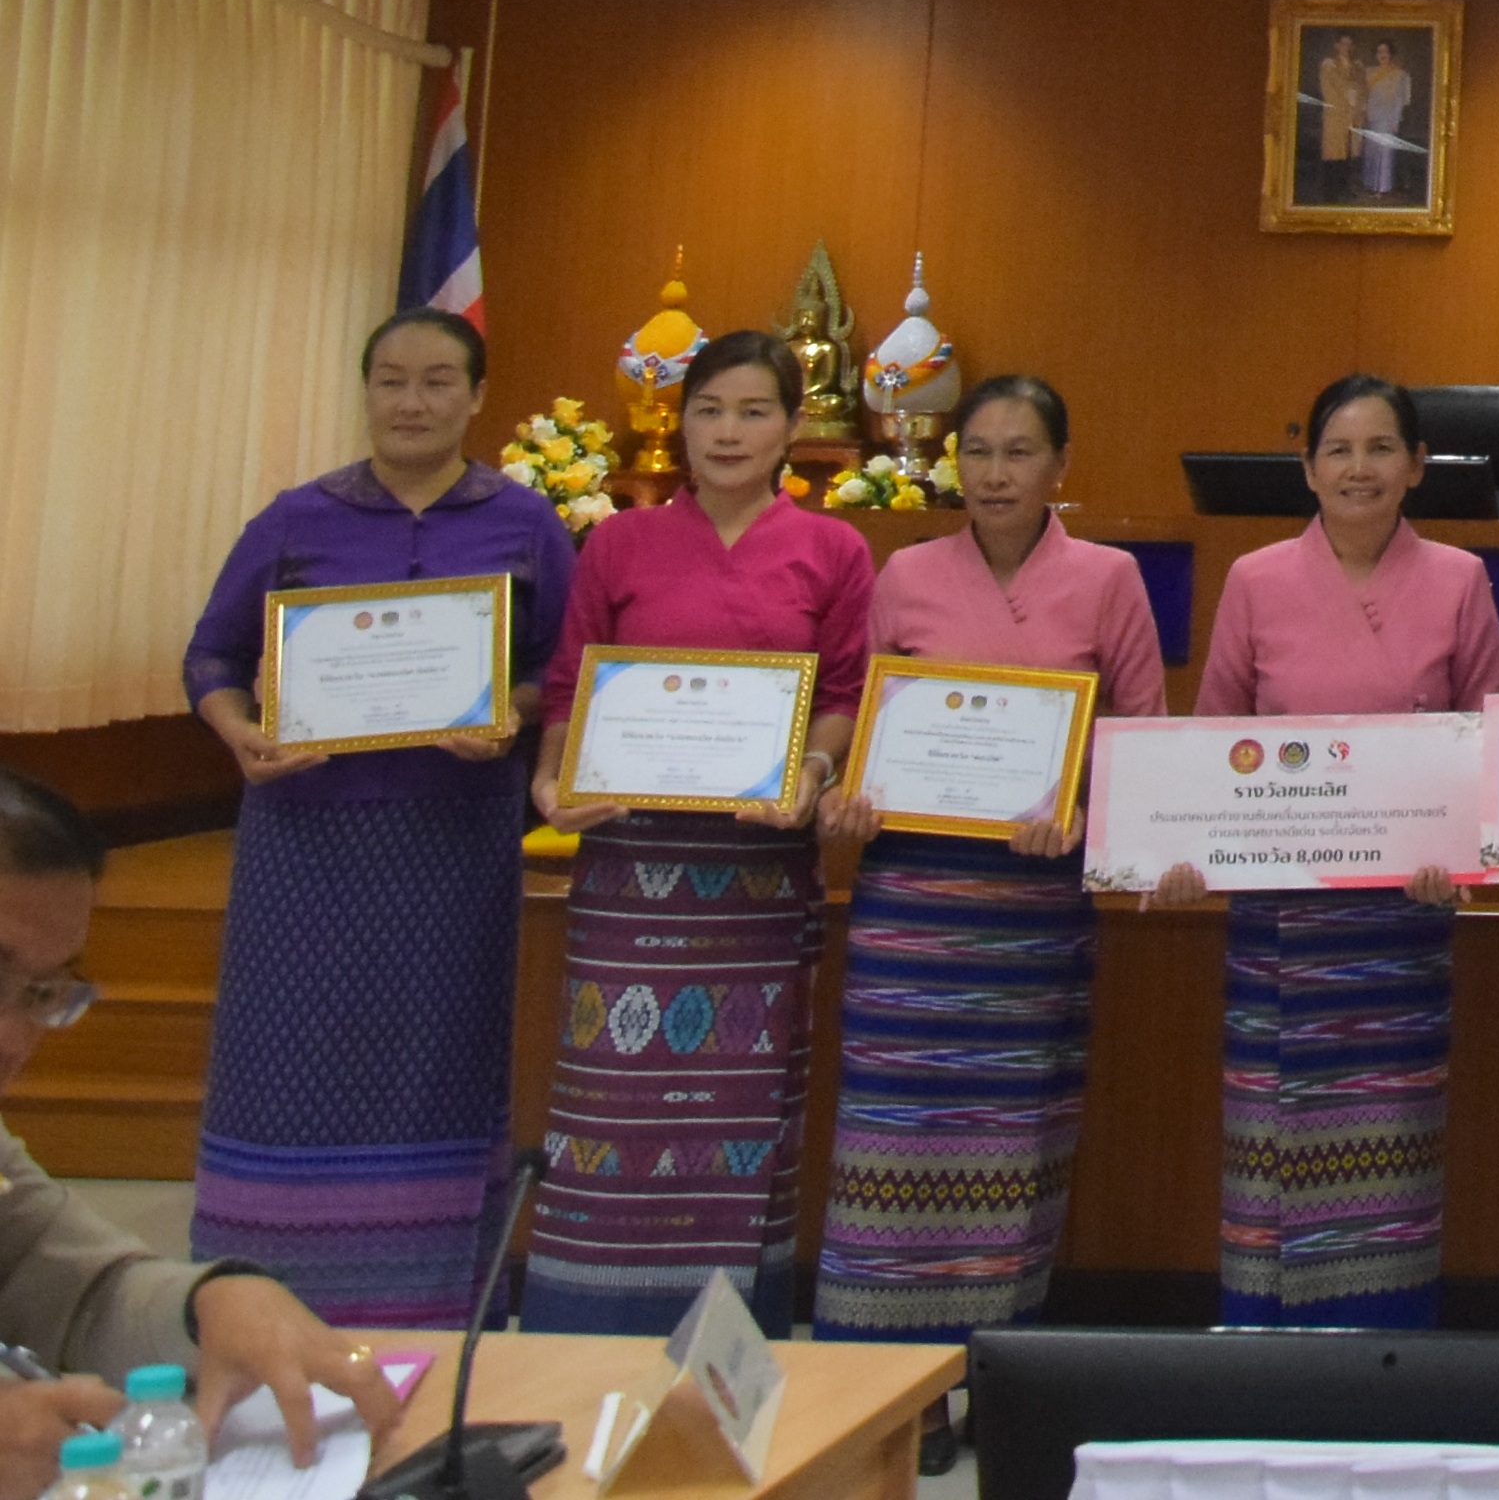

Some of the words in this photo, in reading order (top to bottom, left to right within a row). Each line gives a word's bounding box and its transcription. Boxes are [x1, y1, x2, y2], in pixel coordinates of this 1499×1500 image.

[1234, 781, 1348, 799] รางวัลชนะเลิศ
[1208, 847, 1291, 866] เงินรางวัล
[1296, 849, 1344, 866] 8,000
[1348, 848, 1382, 863] บาท
